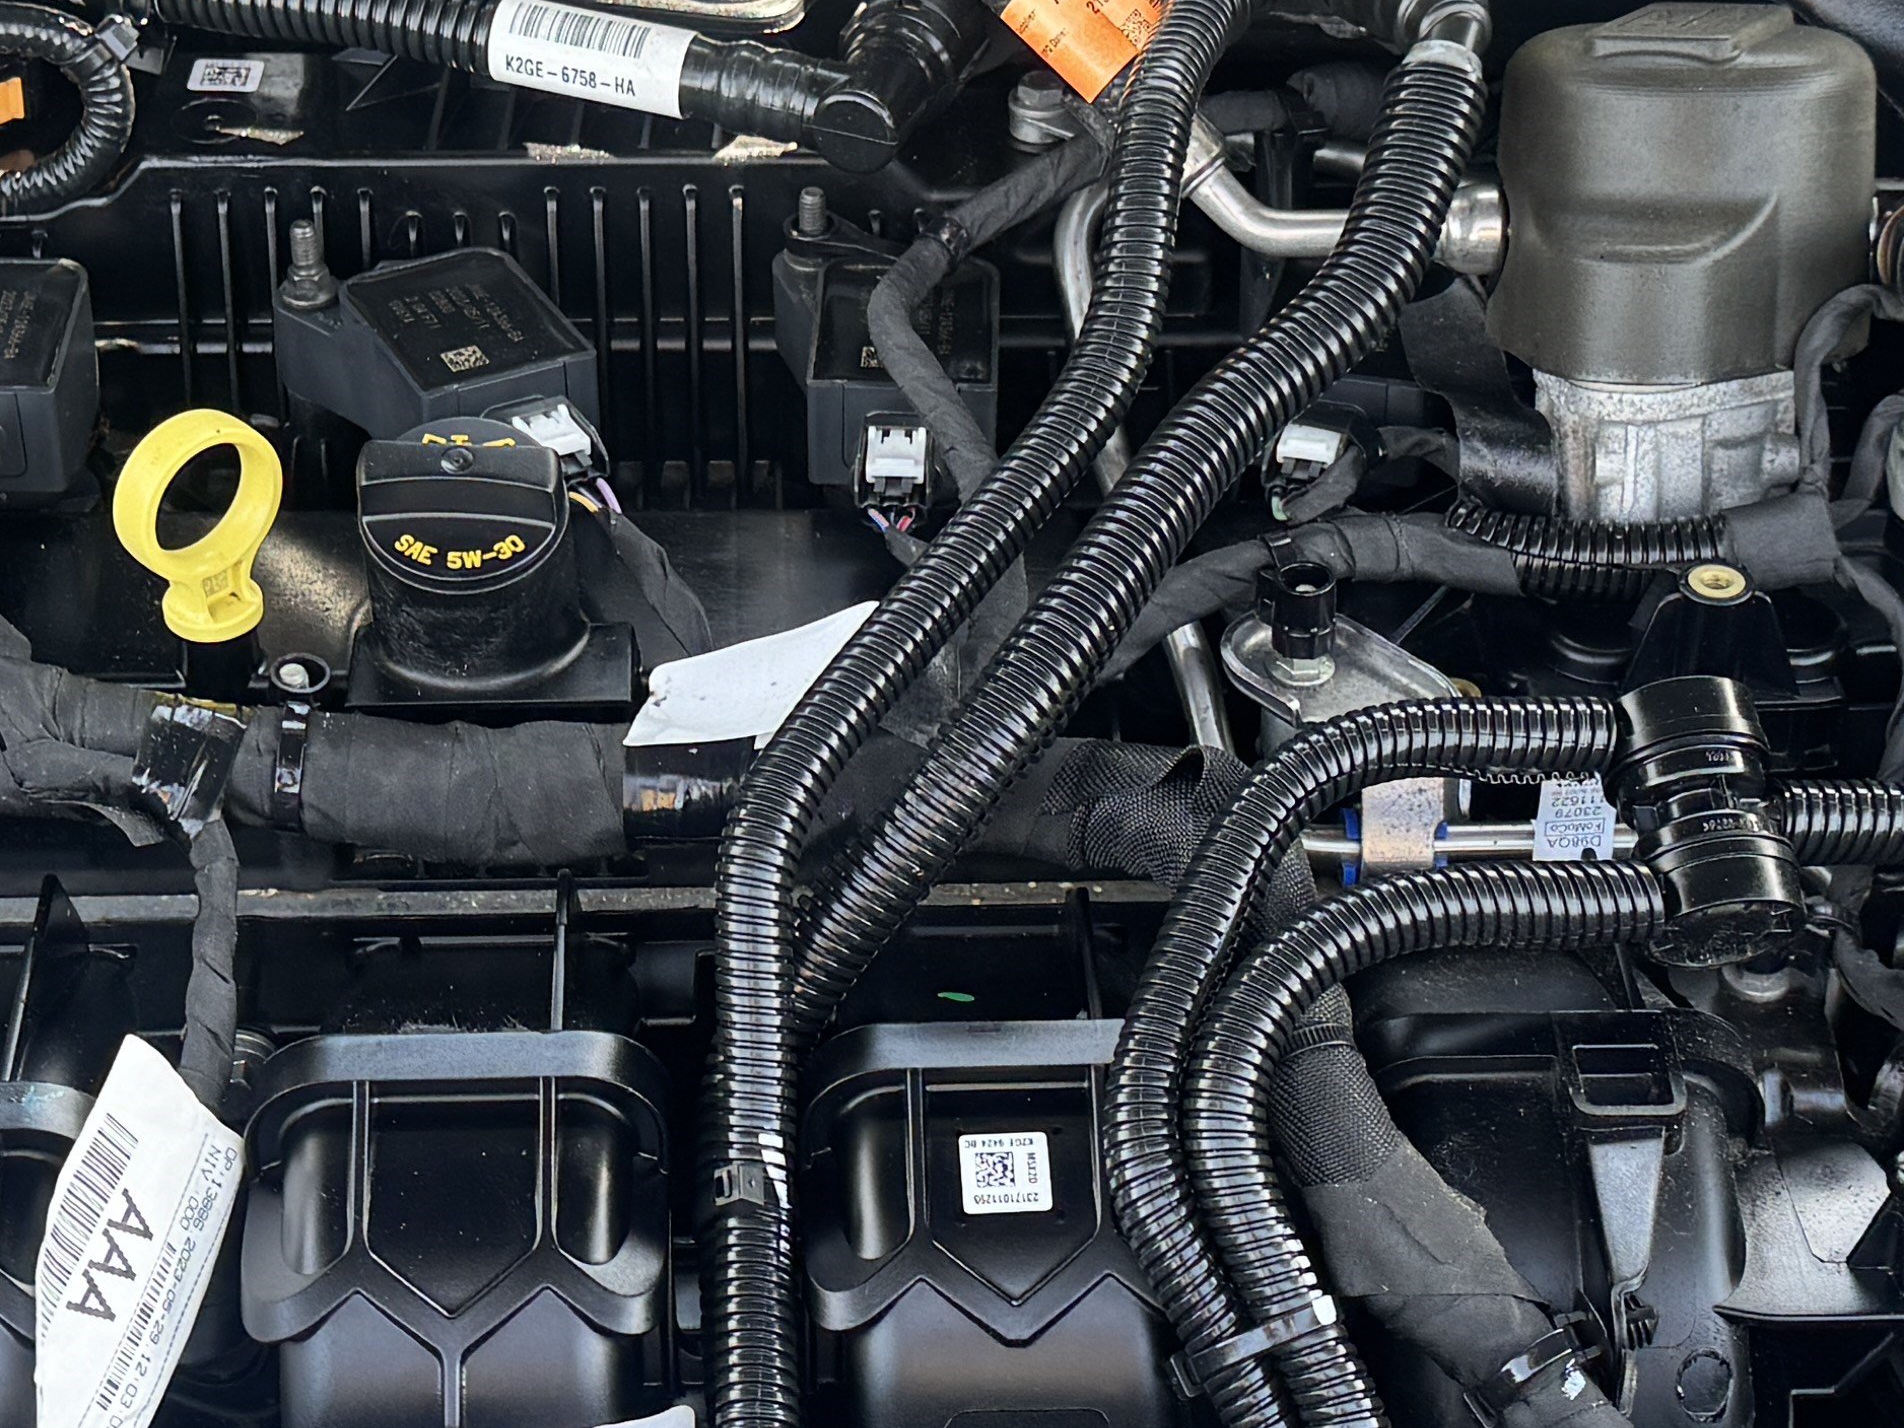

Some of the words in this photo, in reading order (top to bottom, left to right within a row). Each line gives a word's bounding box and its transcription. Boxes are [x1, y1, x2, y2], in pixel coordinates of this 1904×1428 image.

[393, 533, 439, 567] SAE
[445, 533, 528, 570] 5W-30
[66, 1187, 154, 1324] AAA
